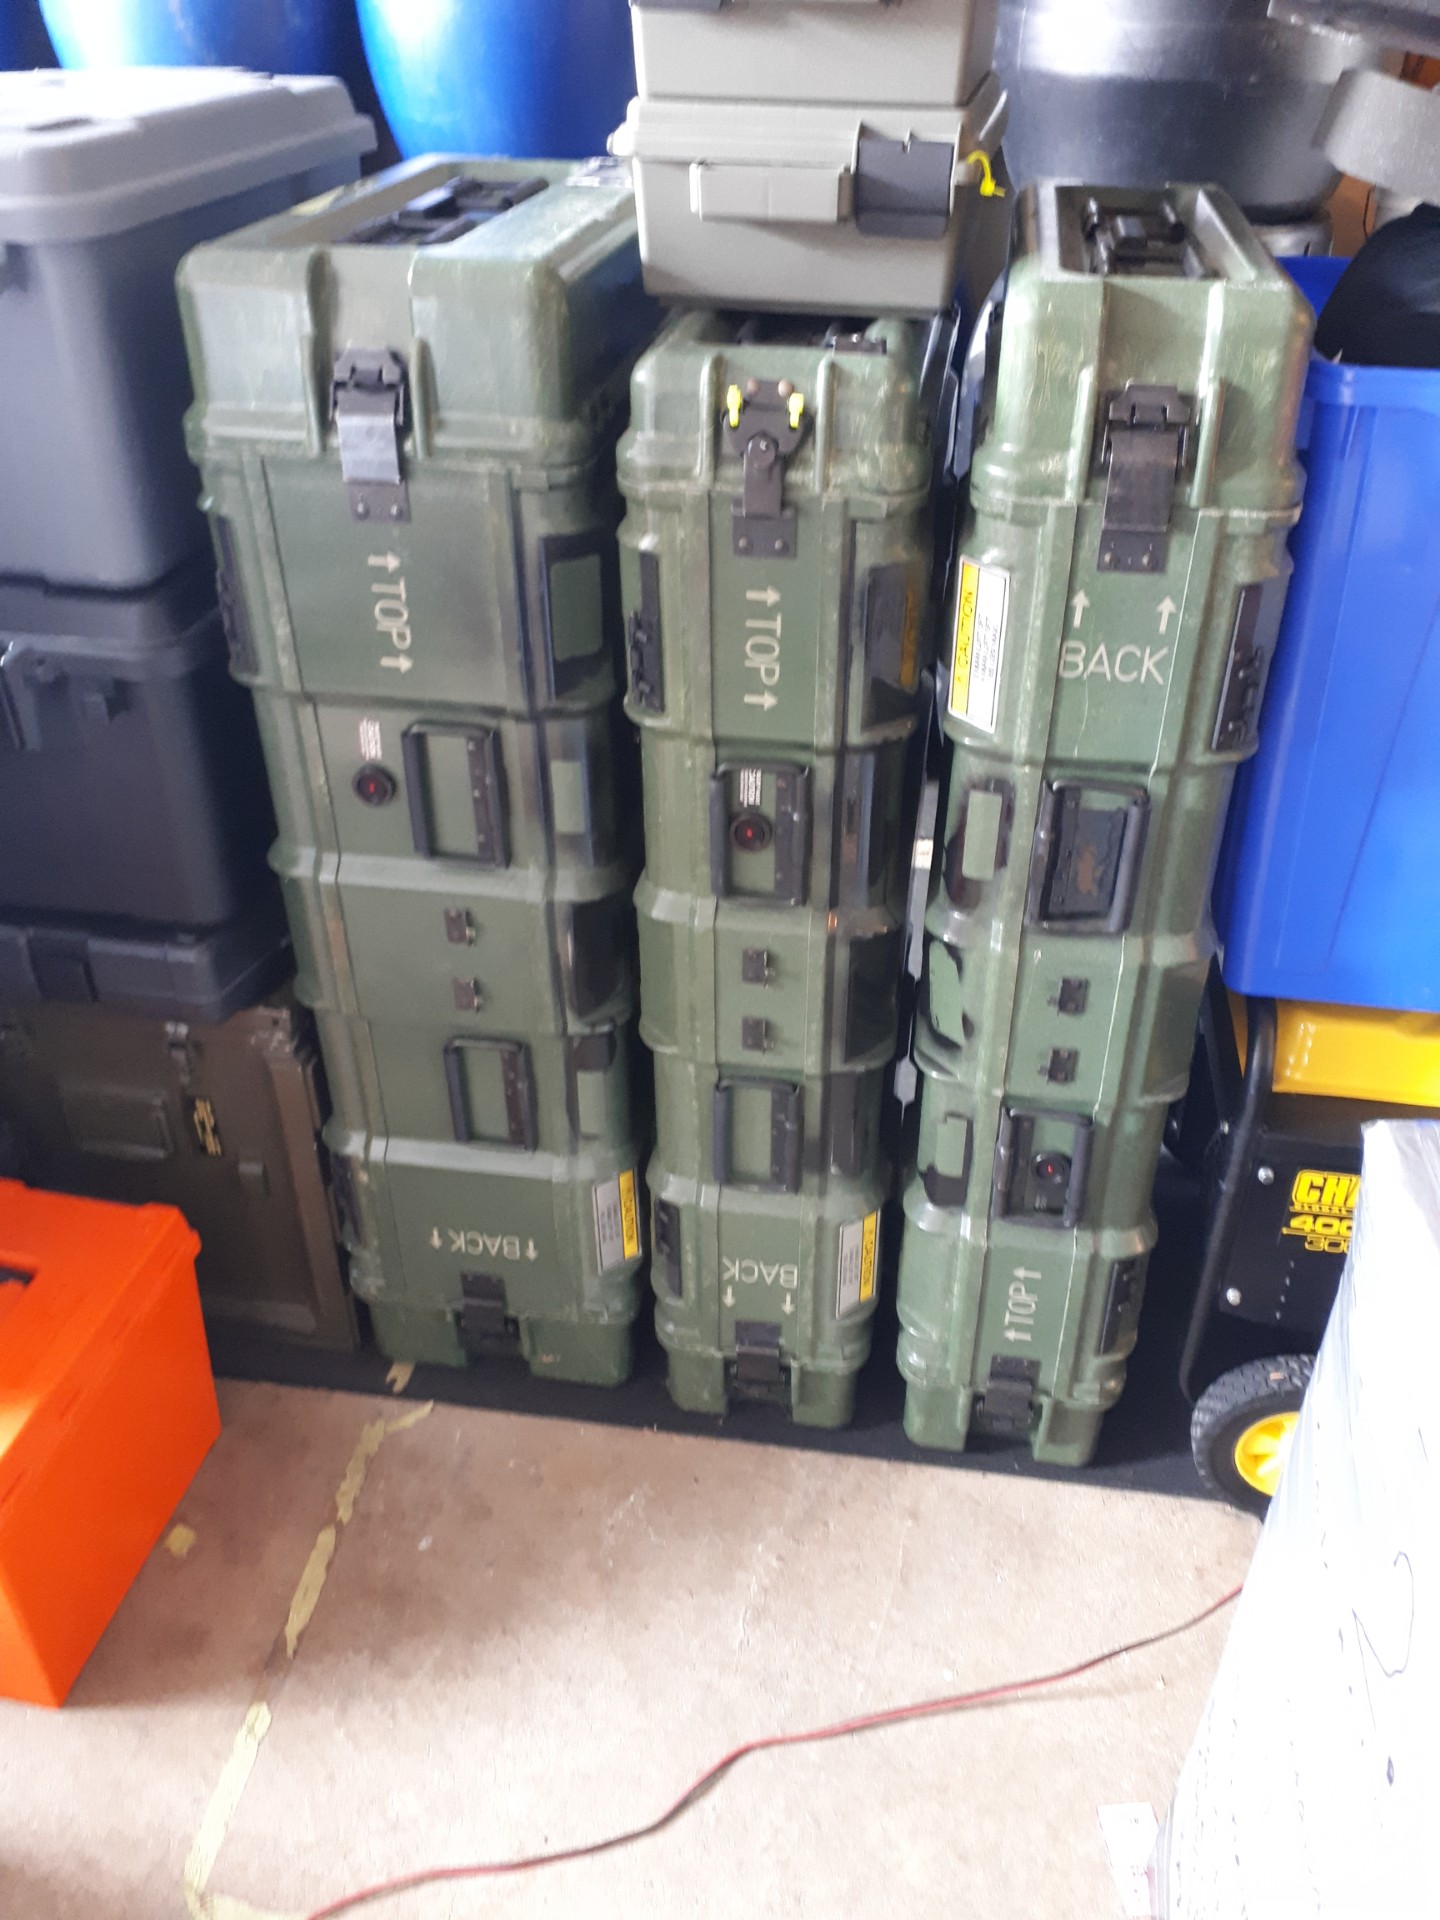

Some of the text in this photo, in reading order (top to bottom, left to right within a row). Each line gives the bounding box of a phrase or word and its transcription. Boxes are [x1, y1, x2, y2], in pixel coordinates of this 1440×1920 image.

[371, 577, 412, 650] TOP
[957, 591, 973, 669] CAUTION
[744, 612, 782, 686] TOP
[1059, 640, 1169, 685] BACK
[448, 1228, 520, 1261] BACK
[1305, 1235, 1349, 1253] 30
[722, 1255, 798, 1289] BACK
[1004, 1281, 1038, 1326] TOP
